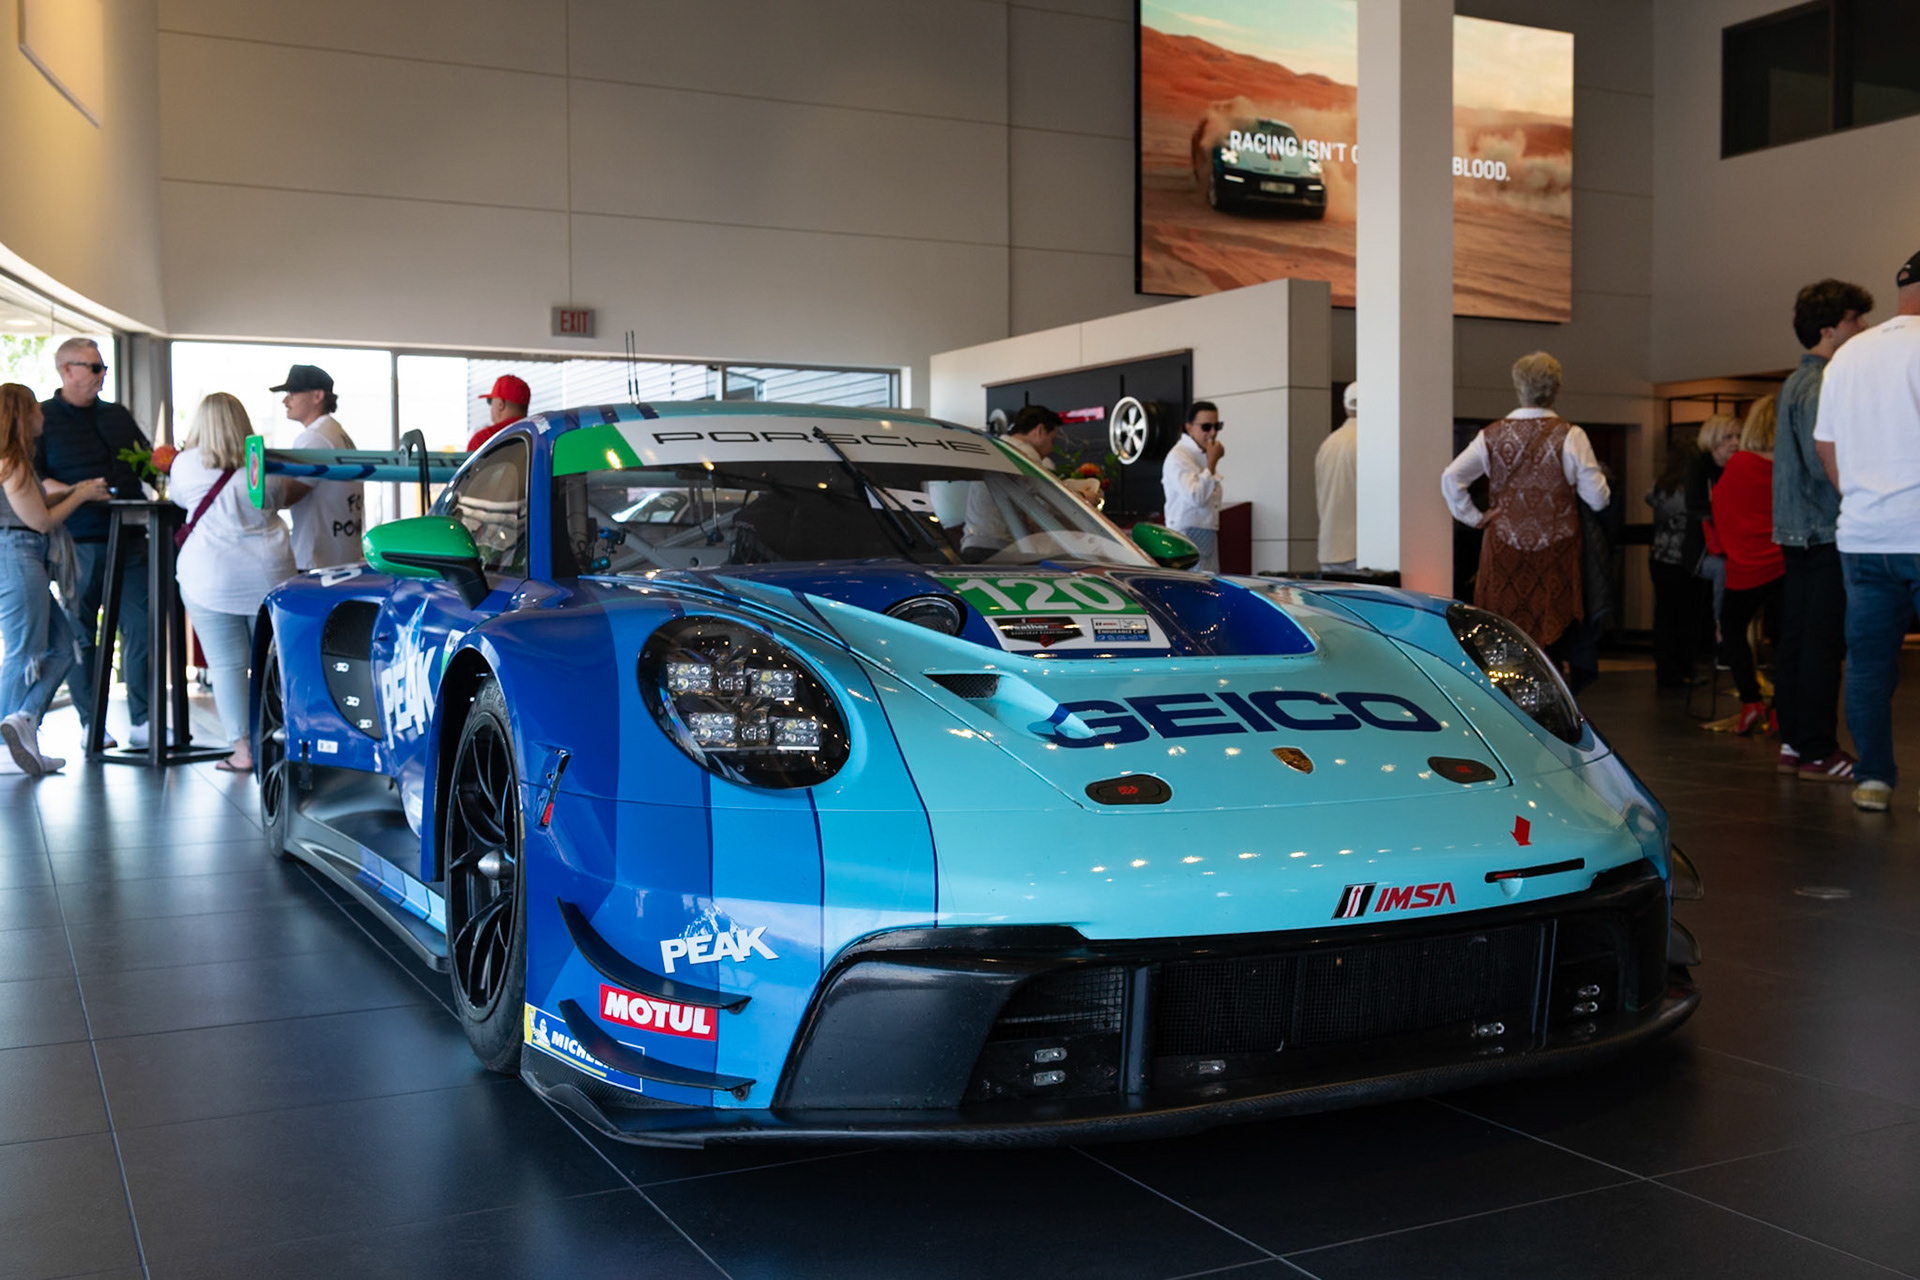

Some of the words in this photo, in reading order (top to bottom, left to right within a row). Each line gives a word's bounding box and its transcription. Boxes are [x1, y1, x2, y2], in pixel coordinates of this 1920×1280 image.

[1230, 130, 1298, 158] RACING
[1302, 139, 1348, 163] ISN'T
[1452, 156, 1511, 182] BLOOD.
[560, 310, 589, 333] EXIT
[651, 430, 991, 456] PORSCHE
[955, 578, 1127, 611] 120
[381, 645, 437, 751] PEAK
[1051, 690, 1443, 749] GEICO
[1374, 882, 1457, 913] IMSA
[659, 926, 780, 974] PEAK
[604, 991, 711, 1035] MOTUL
